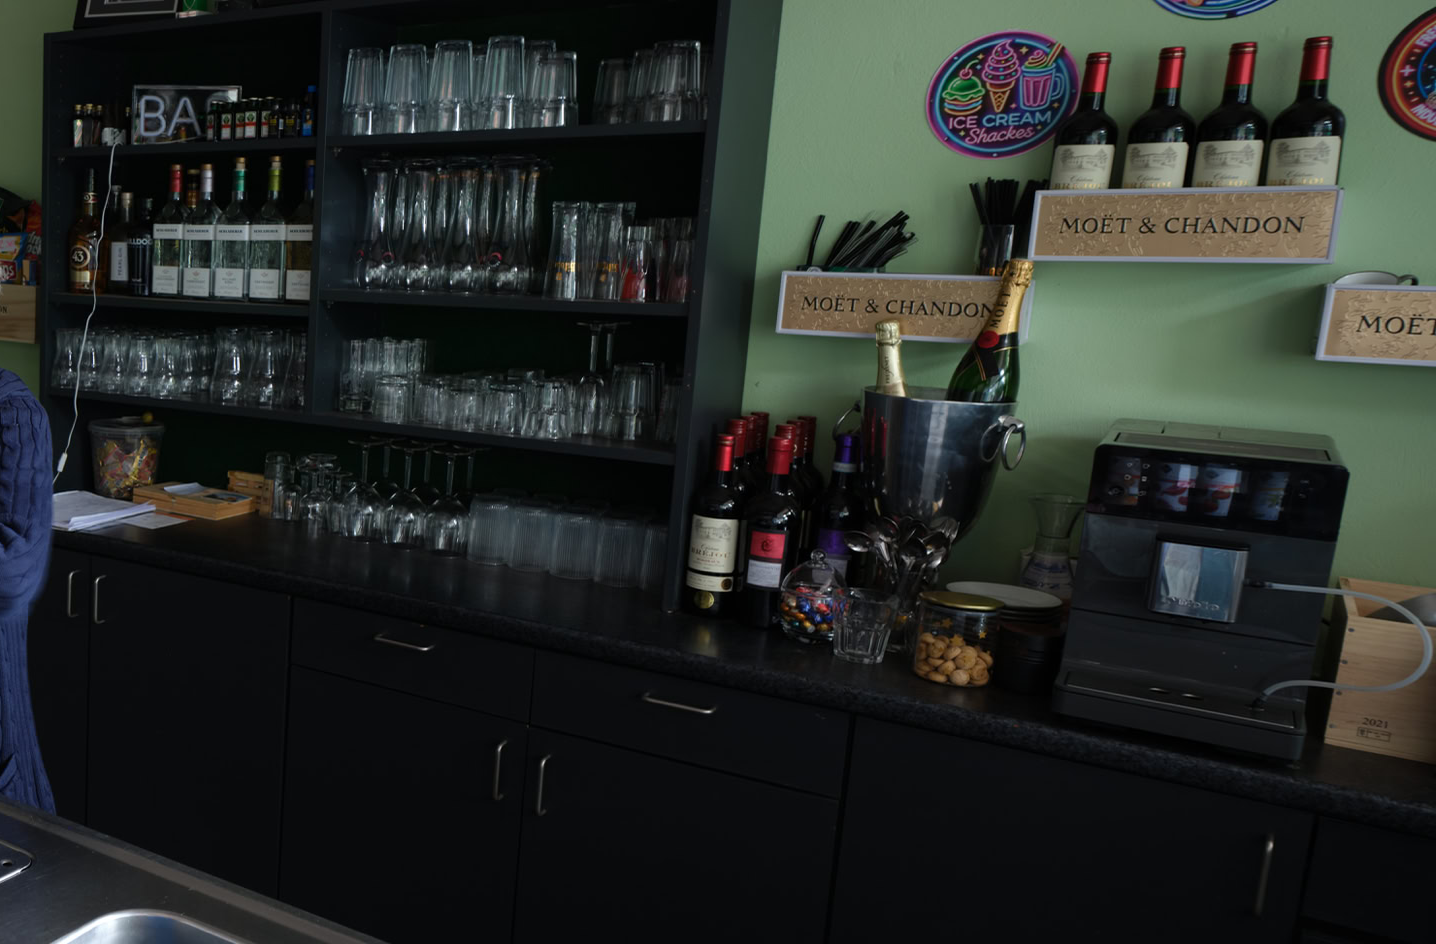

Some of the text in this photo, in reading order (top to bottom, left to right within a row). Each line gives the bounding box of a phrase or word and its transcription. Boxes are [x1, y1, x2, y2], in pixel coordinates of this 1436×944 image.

[949, 110, 1052, 129] ICE CREAM
[965, 125, 1036, 145] Shackes
[1059, 213, 1306, 234] MOËT & CHANDON
[72, 250, 85, 262] 43
[801, 294, 997, 319] MOËT & CHANDON
[1362, 717, 1389, 729] 2021
